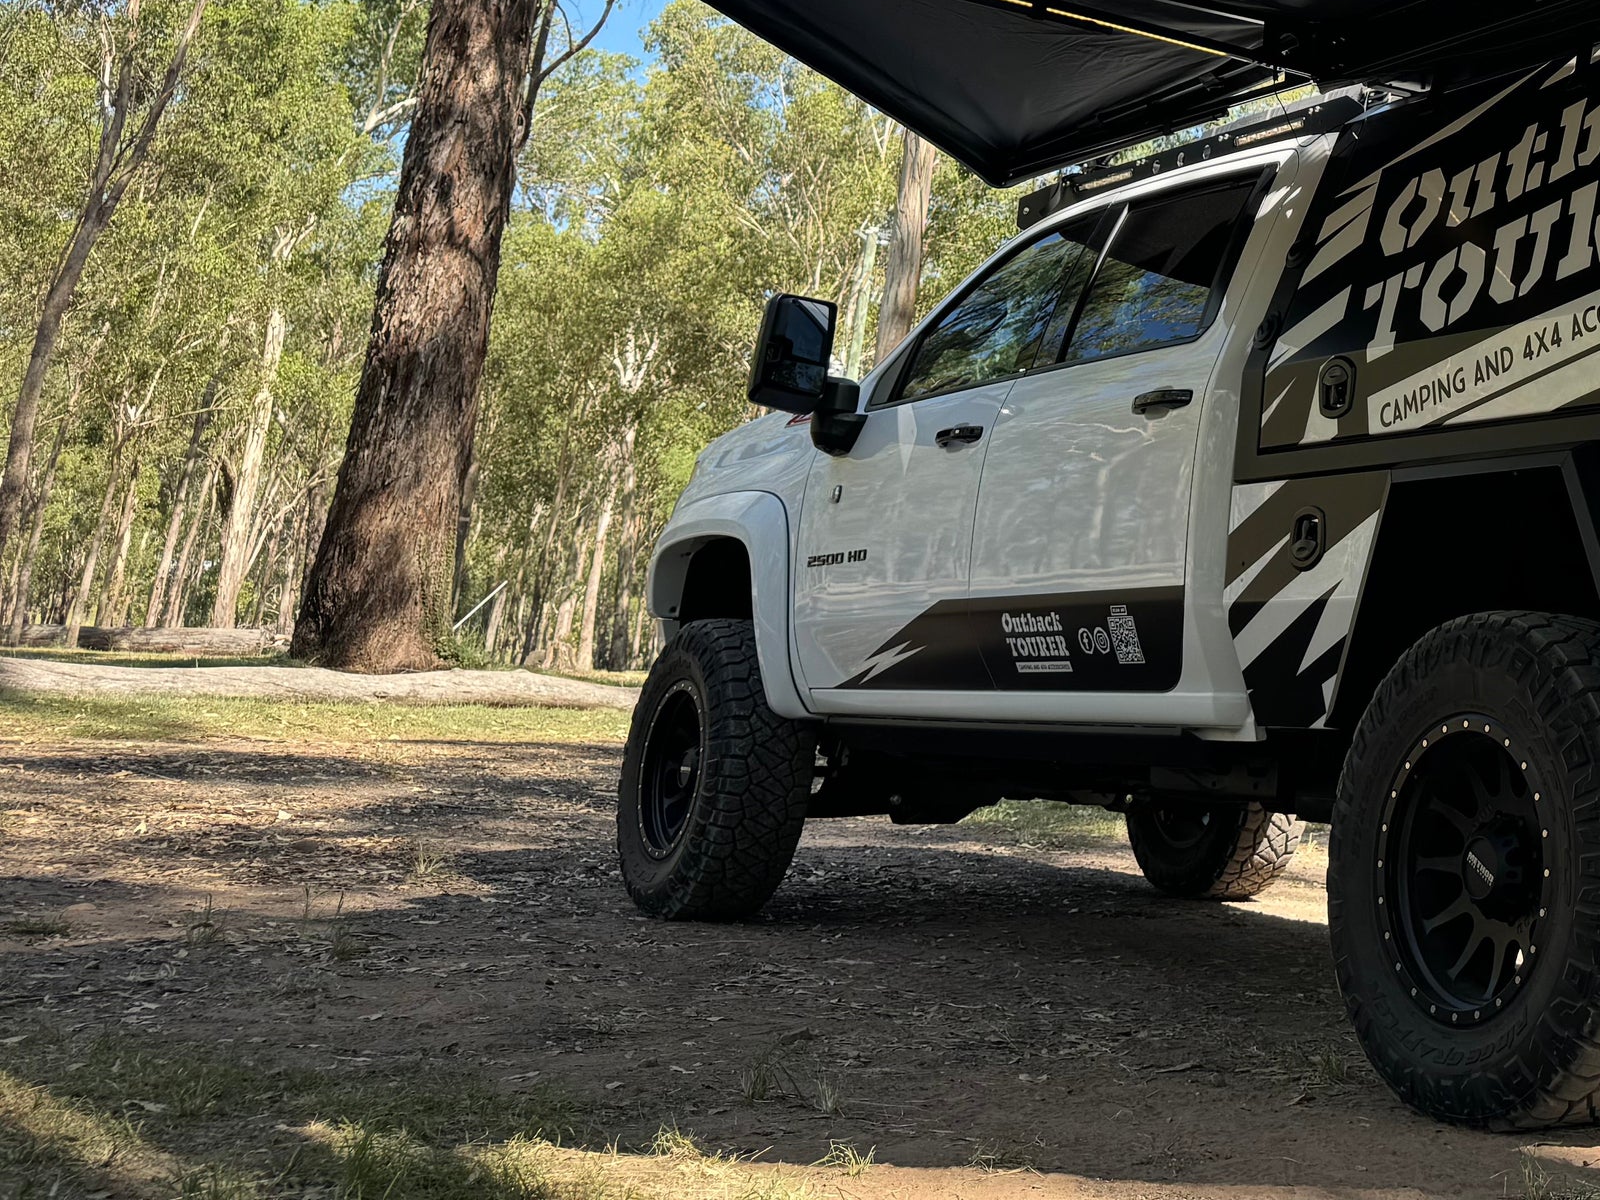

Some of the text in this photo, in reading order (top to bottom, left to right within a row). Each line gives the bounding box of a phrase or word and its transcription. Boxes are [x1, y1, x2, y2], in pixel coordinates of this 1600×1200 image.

[1379, 366, 1467, 428] CAMPING
[1474, 345, 1514, 387] AND
[1522, 325, 1563, 362] 4X4
[807, 549, 868, 568] 2500 HD
[1001, 611, 1063, 633] Outback
[1006, 635, 1070, 657] TOURER
